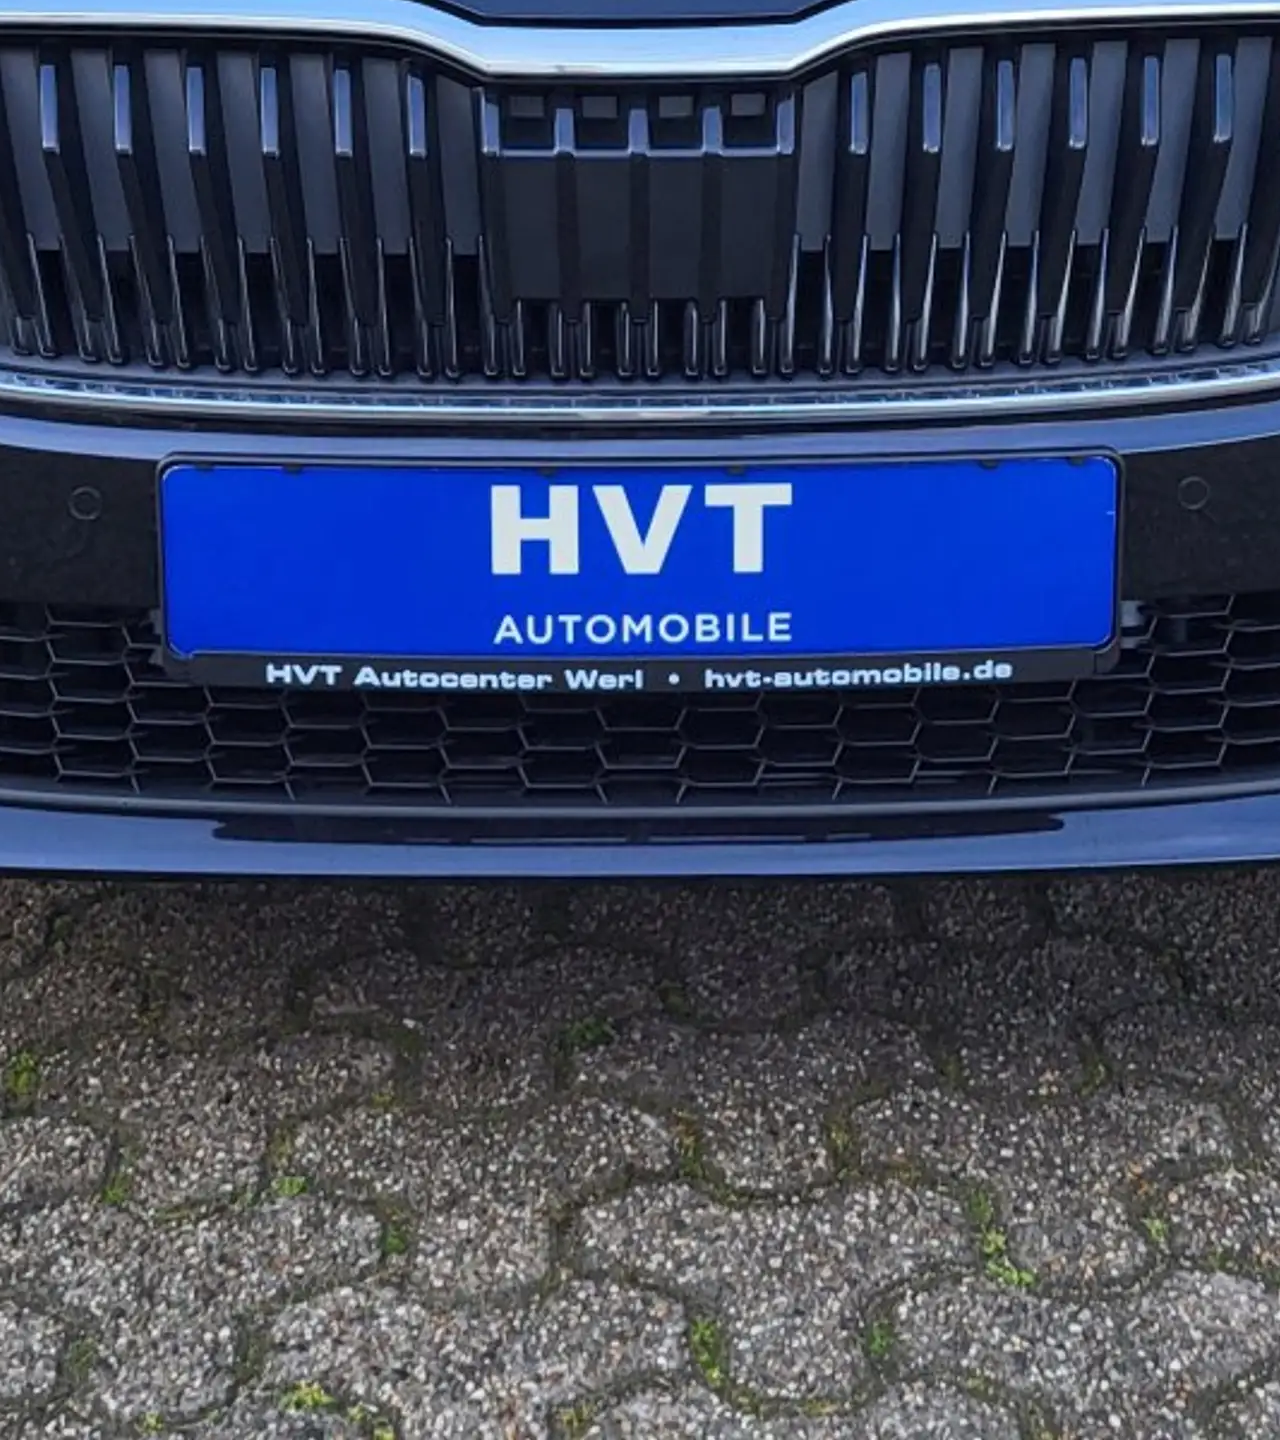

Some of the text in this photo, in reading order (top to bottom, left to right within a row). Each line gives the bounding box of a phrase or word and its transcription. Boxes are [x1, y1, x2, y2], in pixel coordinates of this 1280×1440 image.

[490, 482, 794, 576] HVT
[493, 611, 793, 645] AUTOMOBILE
[265, 658, 1014, 691] HVT Autocenter Werl hvt-automobile.de
